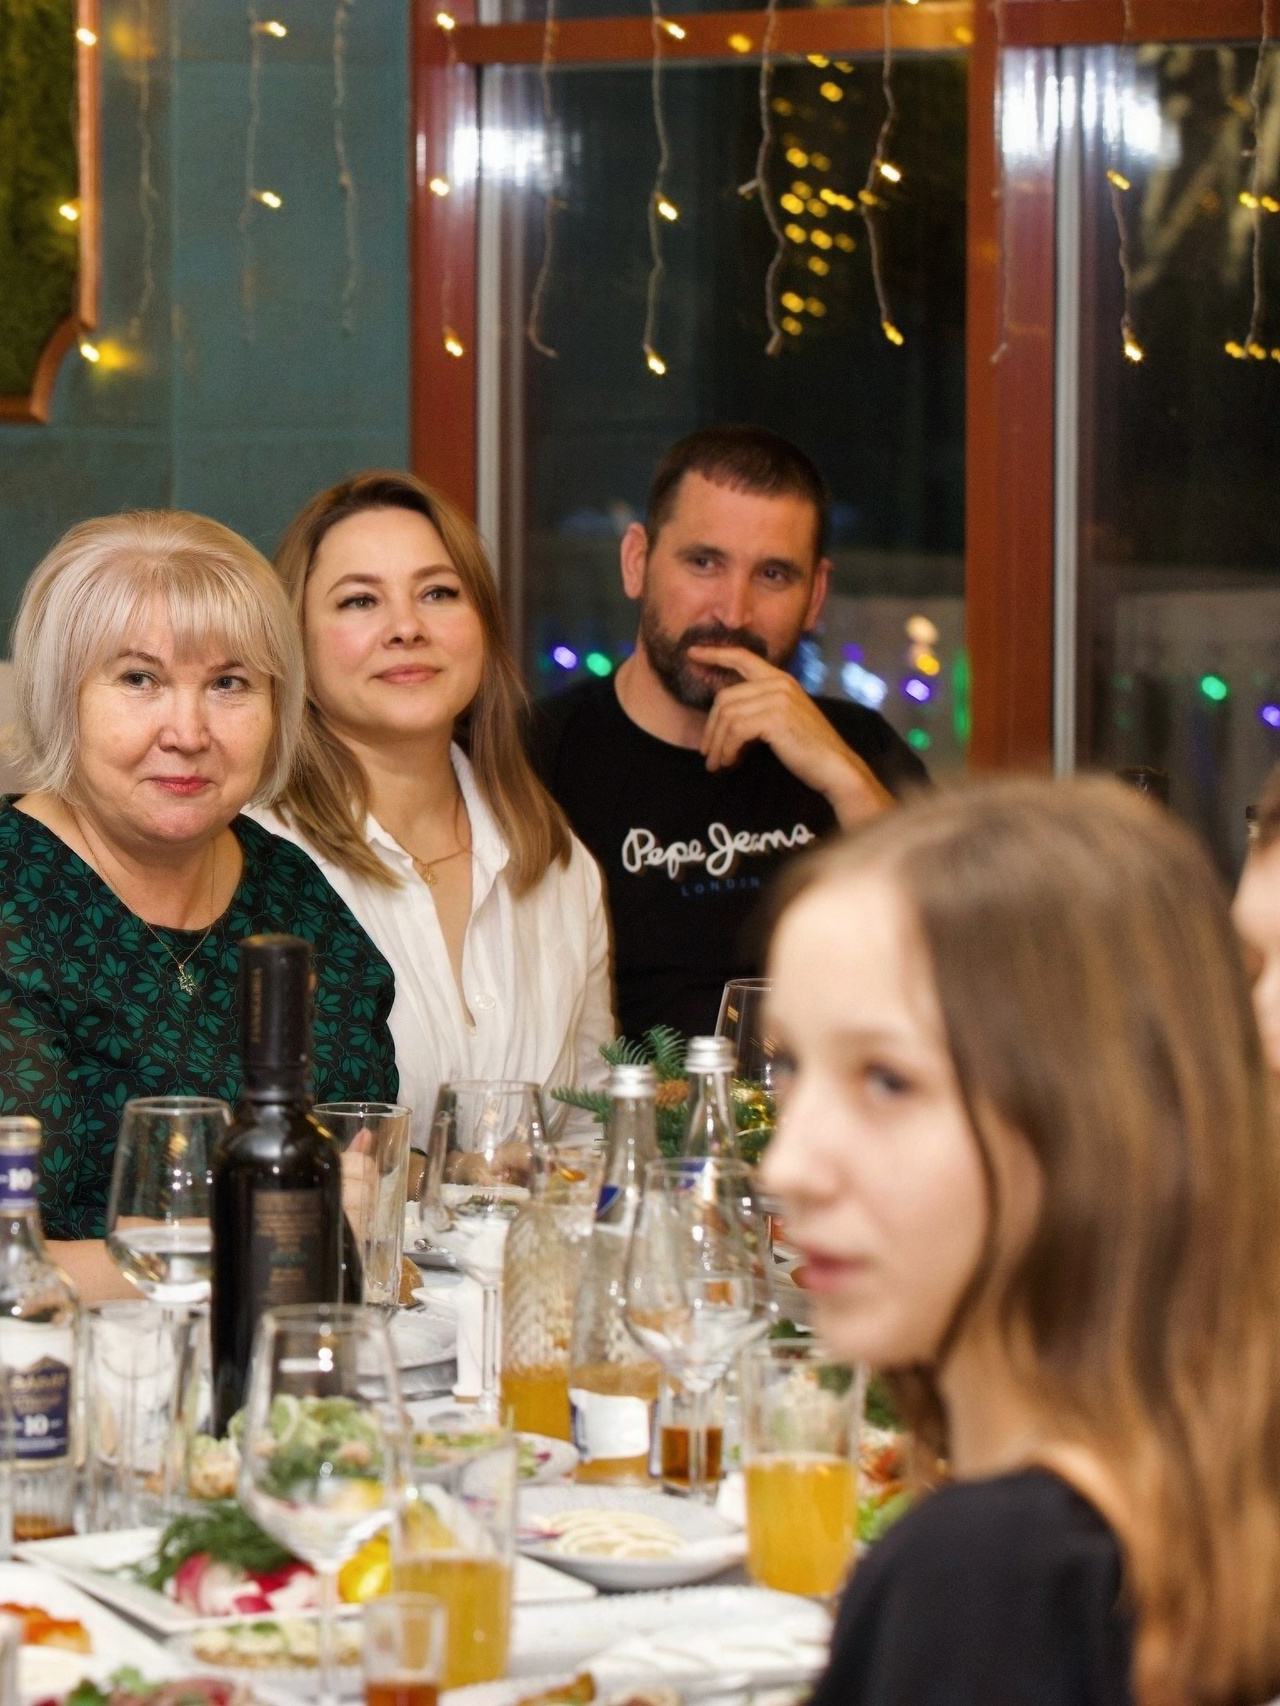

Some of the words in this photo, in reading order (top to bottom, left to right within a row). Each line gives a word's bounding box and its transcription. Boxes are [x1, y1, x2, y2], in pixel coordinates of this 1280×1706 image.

[622, 828, 706, 879] Pepe
[706, 822, 815, 876] Jeans
[8, 1167, 33, 1191] 10
[24, 1413, 49, 1437] 10
